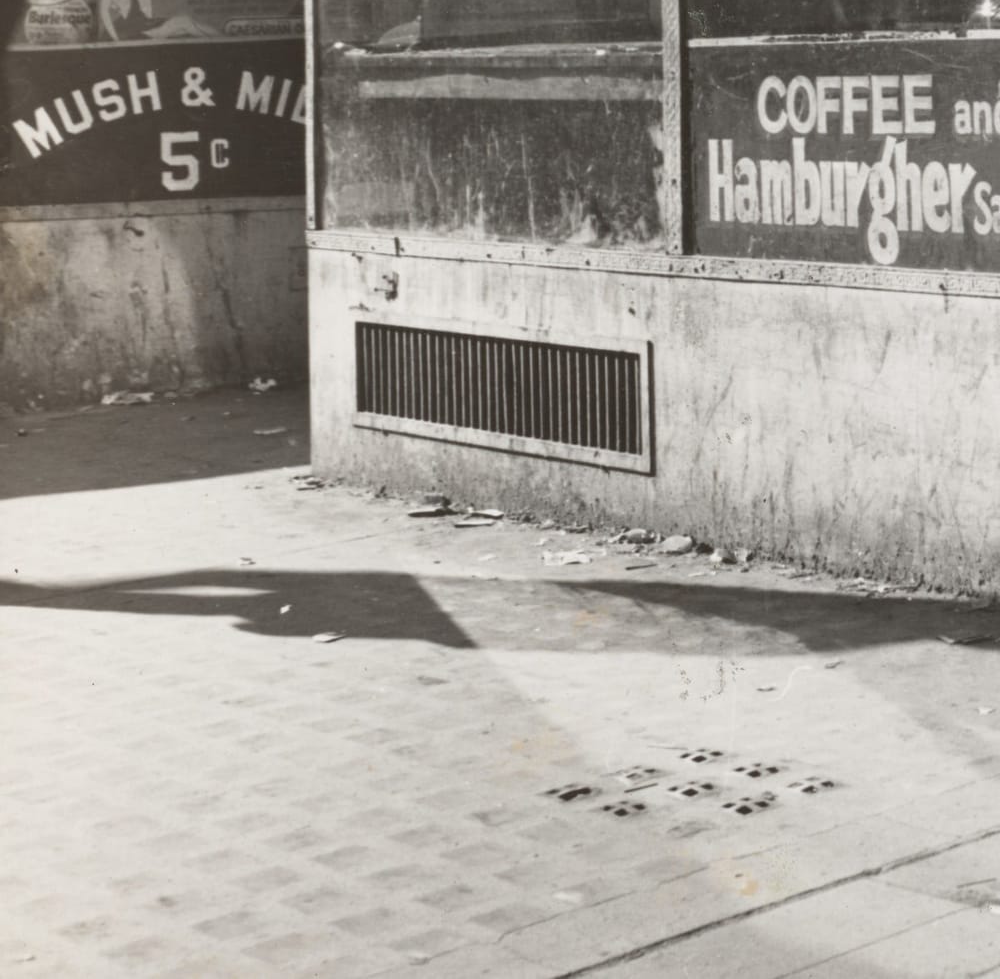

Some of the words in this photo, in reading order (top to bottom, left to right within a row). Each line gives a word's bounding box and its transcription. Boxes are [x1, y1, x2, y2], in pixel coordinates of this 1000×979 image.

[12, 70, 162, 159] MUSH
[181, 67, 216, 106] &
[236, 71, 307, 125] MIL
[757, 74, 936, 134] COFFEE
[708, 135, 977, 265] Hamburgher
